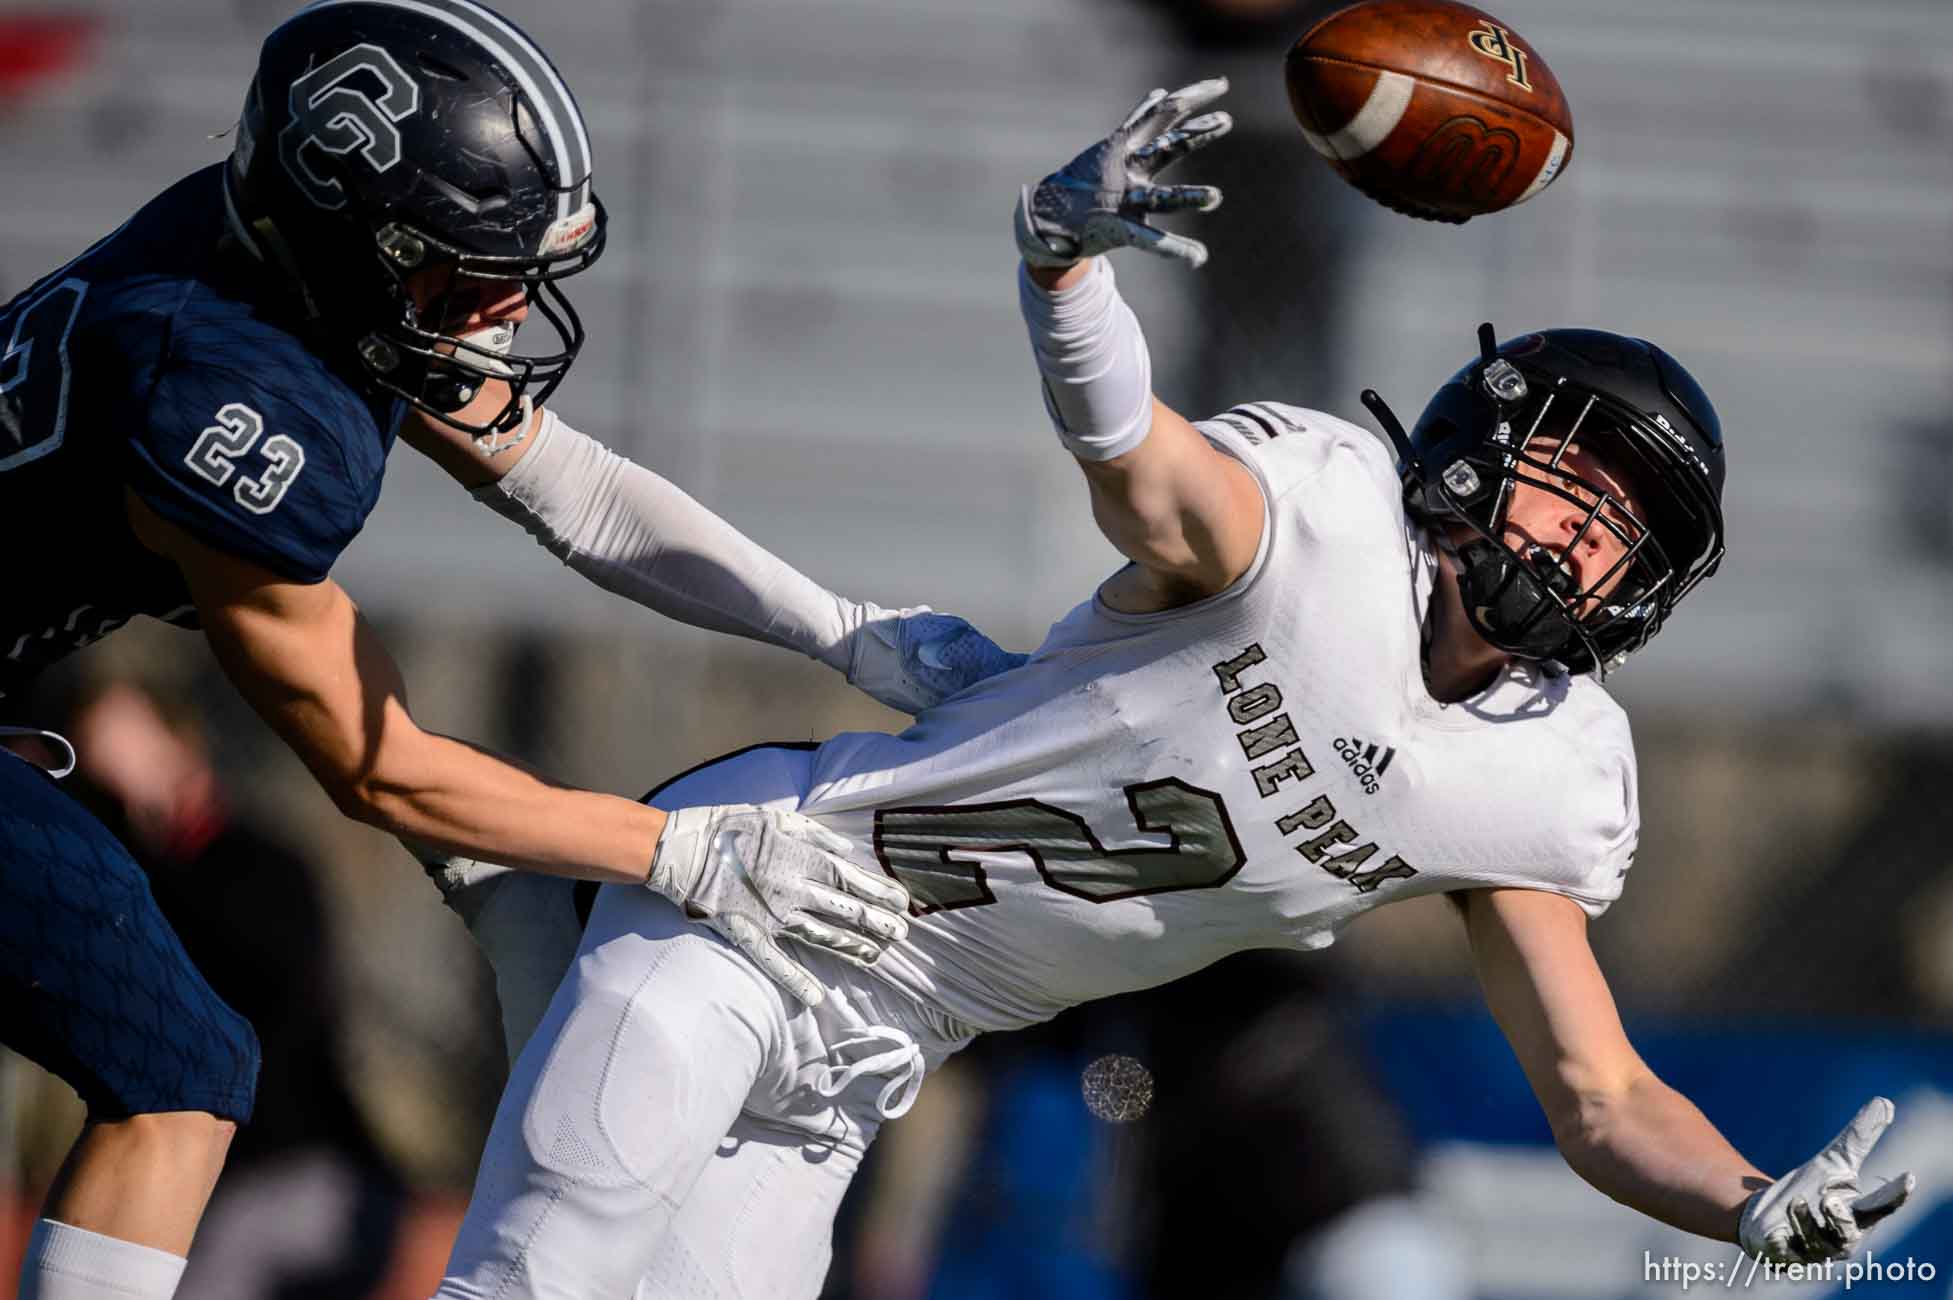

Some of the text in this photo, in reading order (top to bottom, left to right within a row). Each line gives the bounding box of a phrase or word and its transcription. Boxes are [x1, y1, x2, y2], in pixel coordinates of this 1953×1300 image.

[183, 402, 306, 515] 23
[1212, 641, 1420, 894] LONE PEAK
[1332, 736, 1381, 795] adidas
[872, 776, 1248, 917] 2
